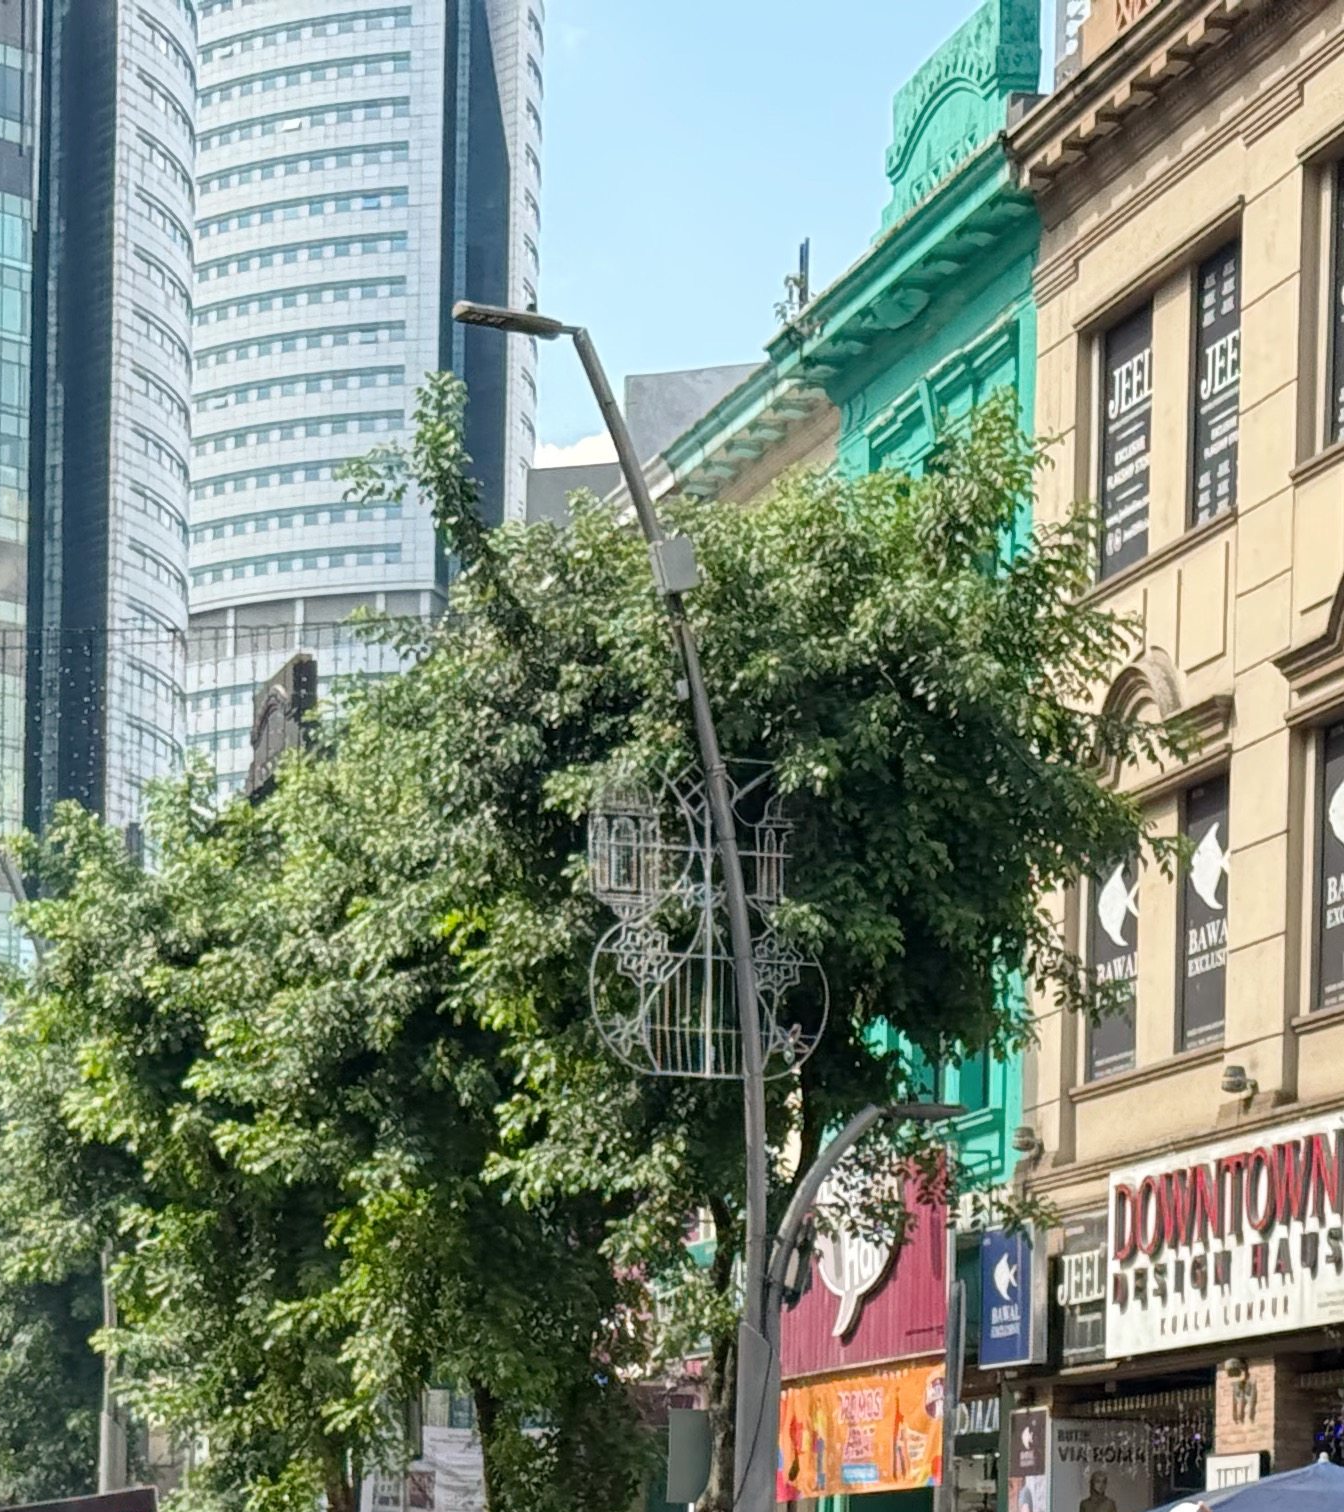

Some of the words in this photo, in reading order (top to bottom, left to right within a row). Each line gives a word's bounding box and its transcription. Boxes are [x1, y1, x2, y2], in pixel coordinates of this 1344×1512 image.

[1058, 1248, 1106, 1307] JEEL
[1112, 1250, 1232, 1312] DESIGN
[1251, 1227, 1344, 1286] HAUS
[1159, 1308, 1212, 1336] KUALA
[1222, 1296, 1290, 1326] LUMPUR
[1057, 1446, 1088, 1464] VIA
